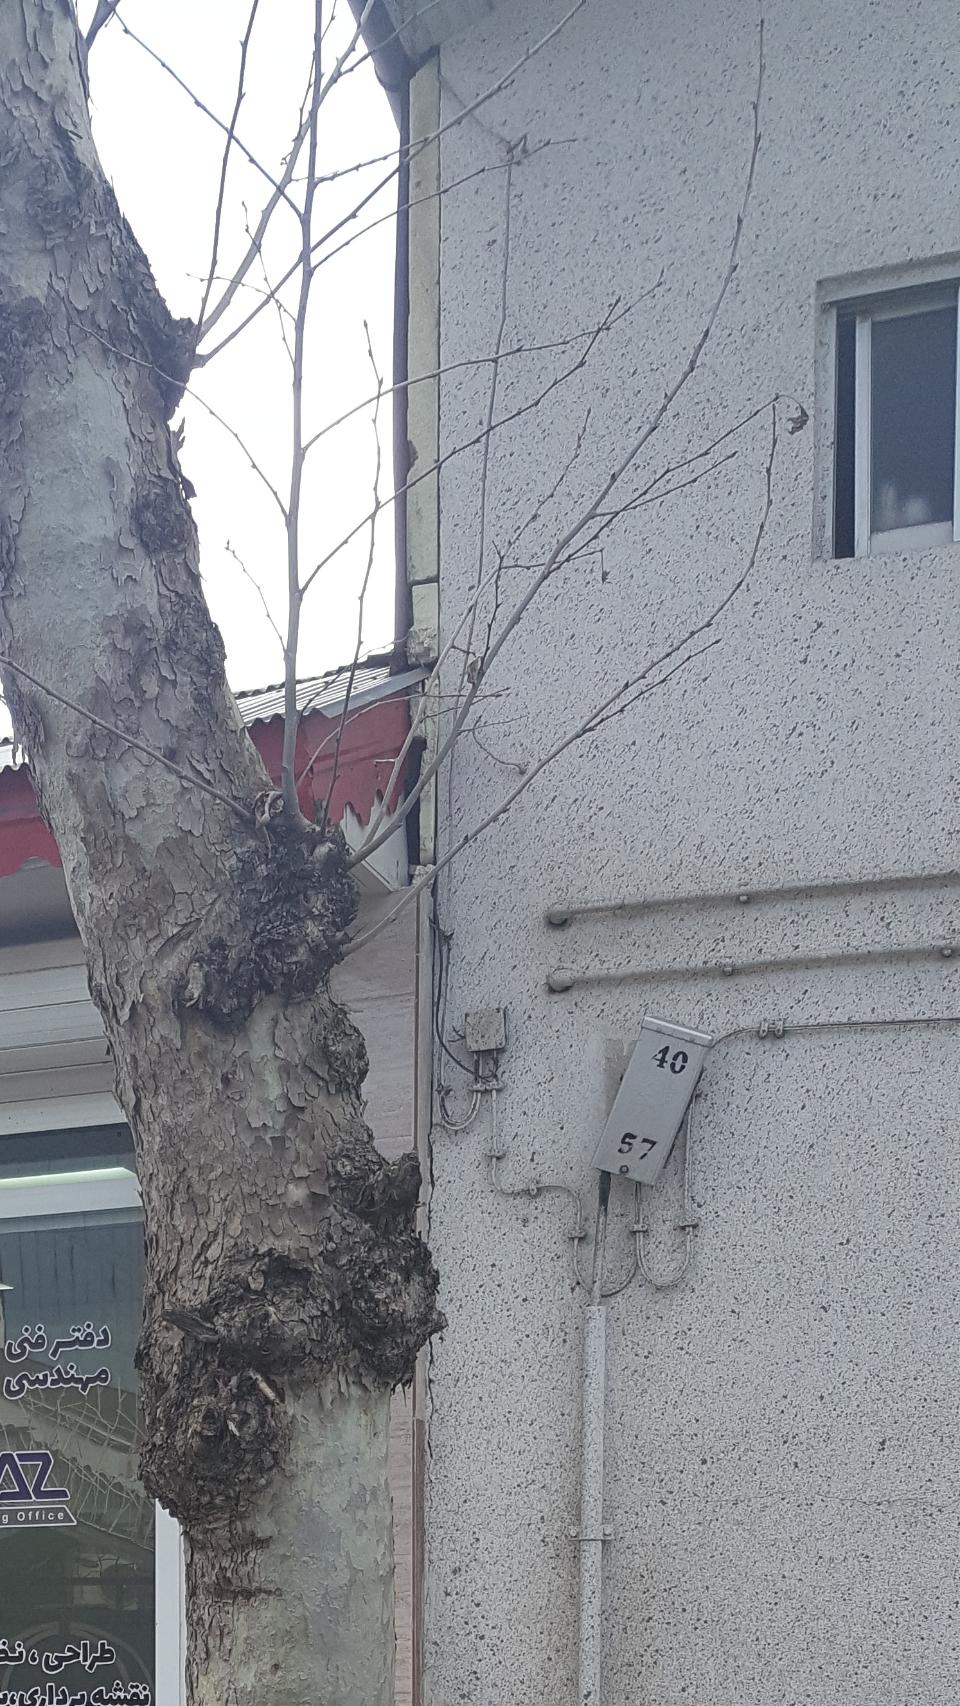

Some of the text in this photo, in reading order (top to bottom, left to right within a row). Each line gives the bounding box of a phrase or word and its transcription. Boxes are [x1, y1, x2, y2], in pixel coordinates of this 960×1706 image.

[651, 1045, 689, 1074] 40
[617, 1132, 658, 1160] 57
[5, 1321, 112, 1363] دفتر فنی
[3, 1363, 112, 1400] مهندسی
[16, 1510, 65, 1523] Office
